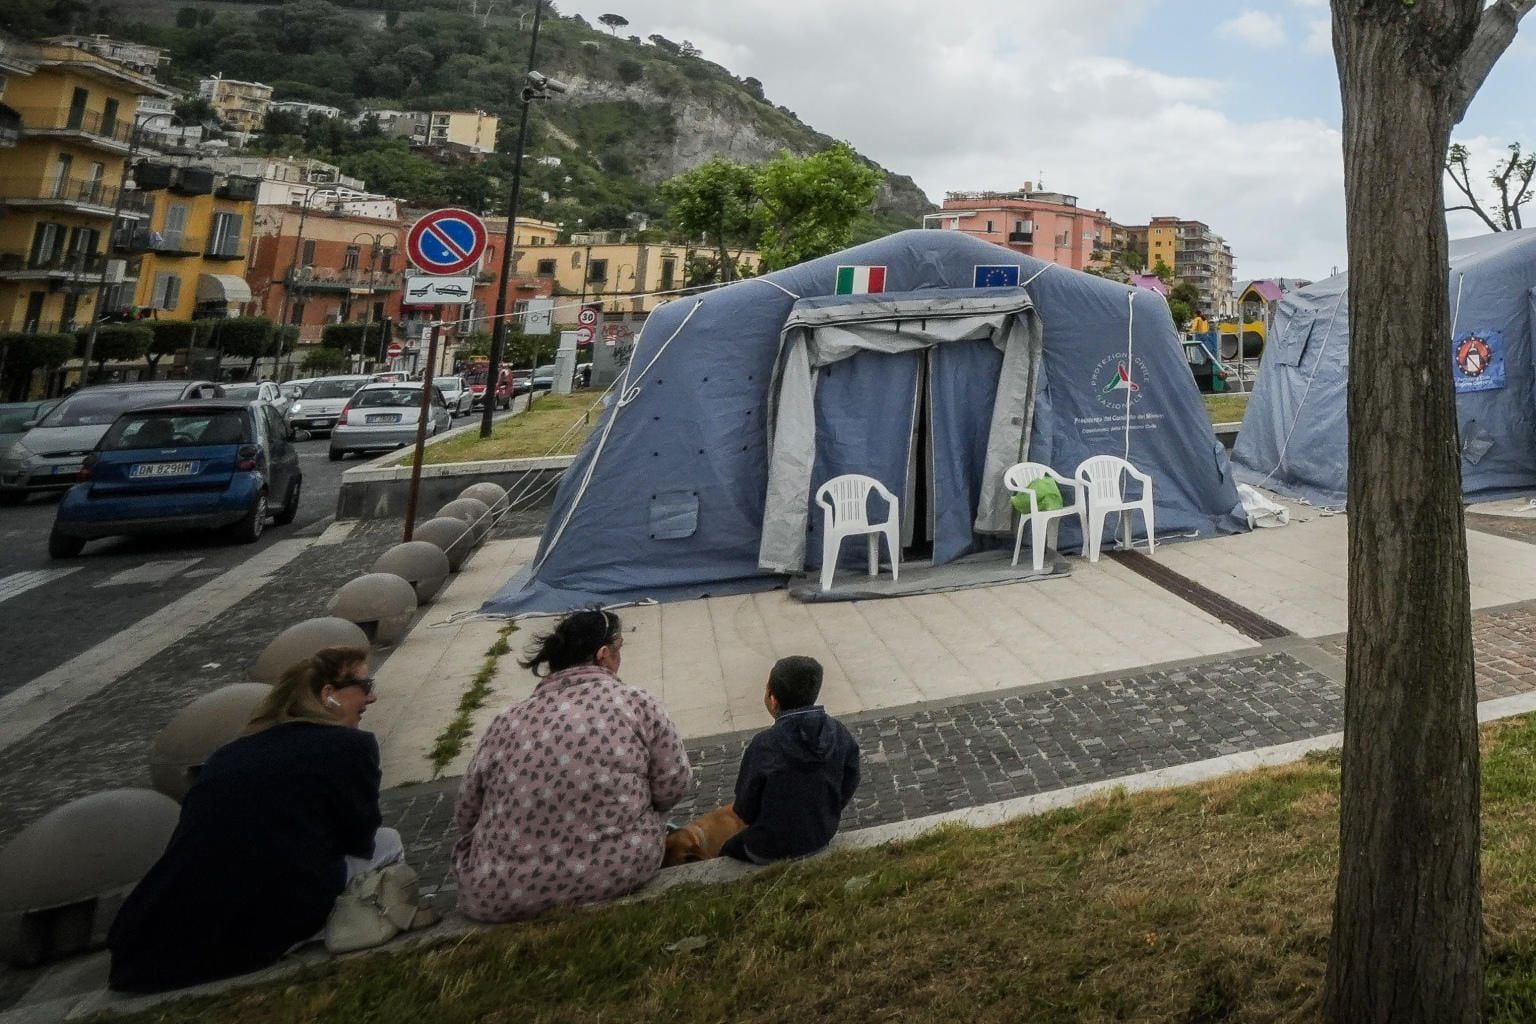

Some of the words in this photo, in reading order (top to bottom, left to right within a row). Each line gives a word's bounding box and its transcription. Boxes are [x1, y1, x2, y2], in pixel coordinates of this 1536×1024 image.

[582, 313, 593, 321] 30
[1135, 357, 1149, 383] CIVILE
[140, 464, 153, 475] DN
